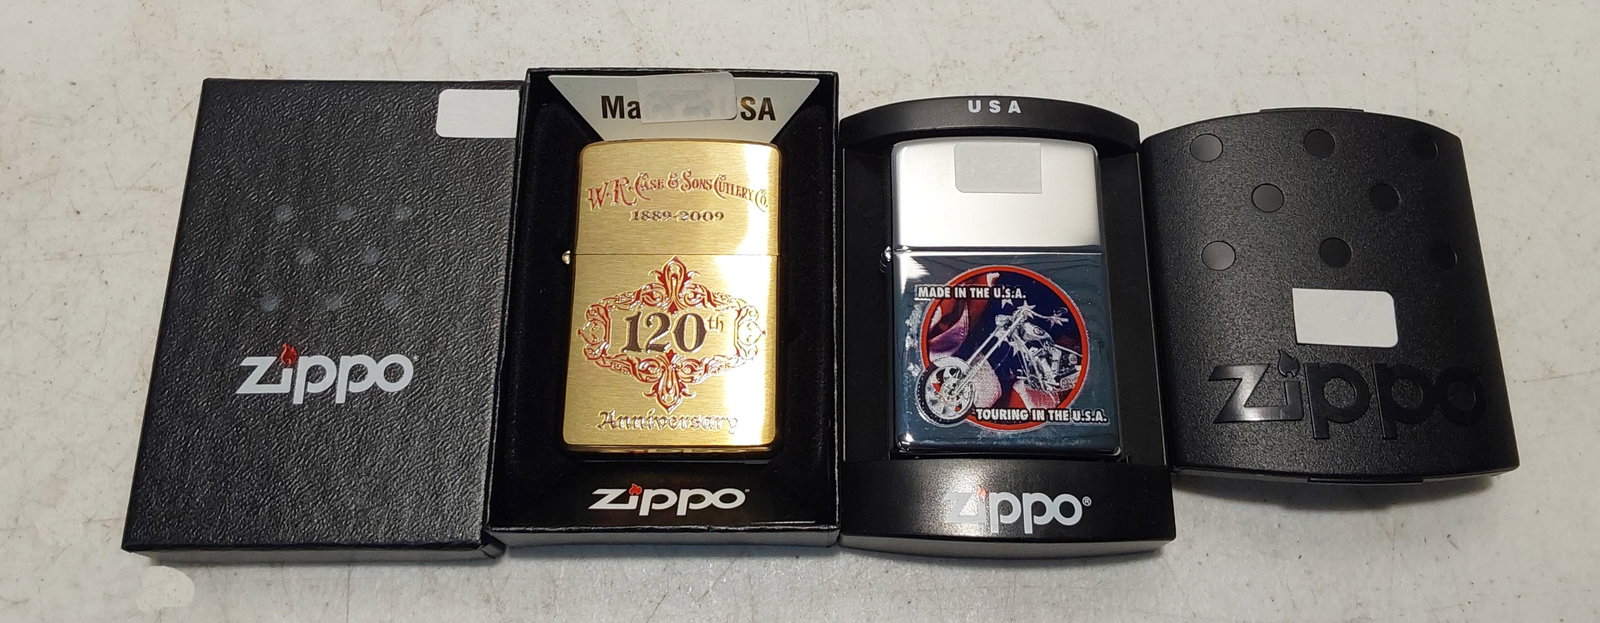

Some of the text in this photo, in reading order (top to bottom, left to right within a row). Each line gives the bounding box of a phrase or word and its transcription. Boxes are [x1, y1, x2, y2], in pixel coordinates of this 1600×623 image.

[968, 99, 1022, 114] USA
[630, 210, 725, 222] 1889-2009
[917, 286, 1027, 300] MADE IN THE U.S.A.
[596, 407, 739, 434] Anniversary
[975, 408, 1029, 421] TOURING
[1032, 408, 1045, 422] IN
[1048, 409, 1069, 422] THE
